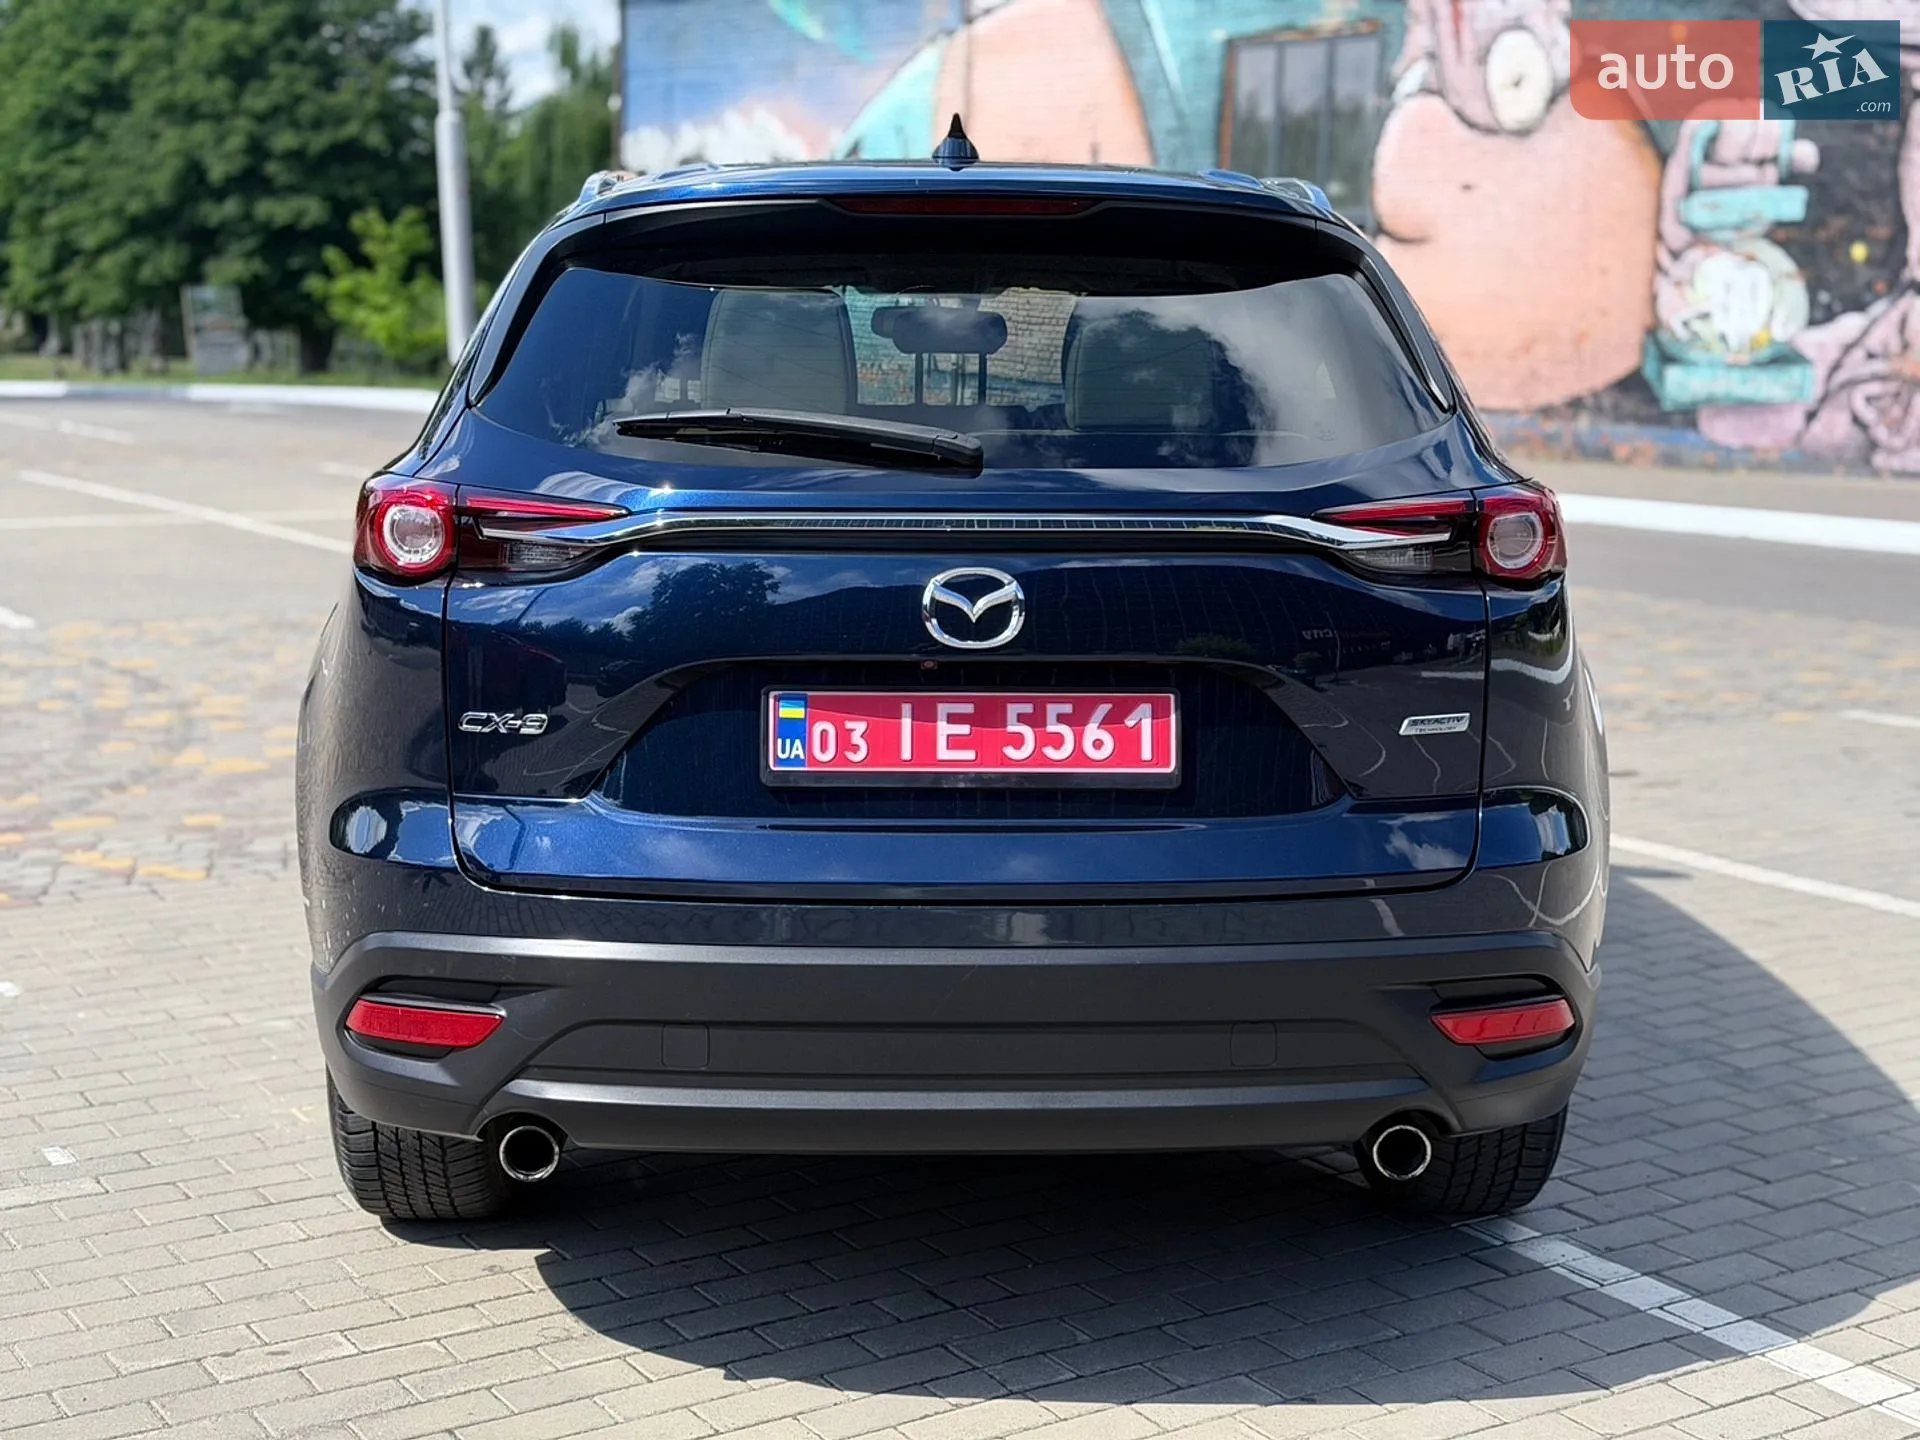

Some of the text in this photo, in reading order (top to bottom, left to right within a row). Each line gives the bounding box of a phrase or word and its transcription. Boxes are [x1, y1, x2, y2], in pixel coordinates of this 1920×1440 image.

[458, 711, 548, 735] CX-9
[811, 702, 1153, 763] 03 IE 5561
[777, 739, 805, 760] UA
